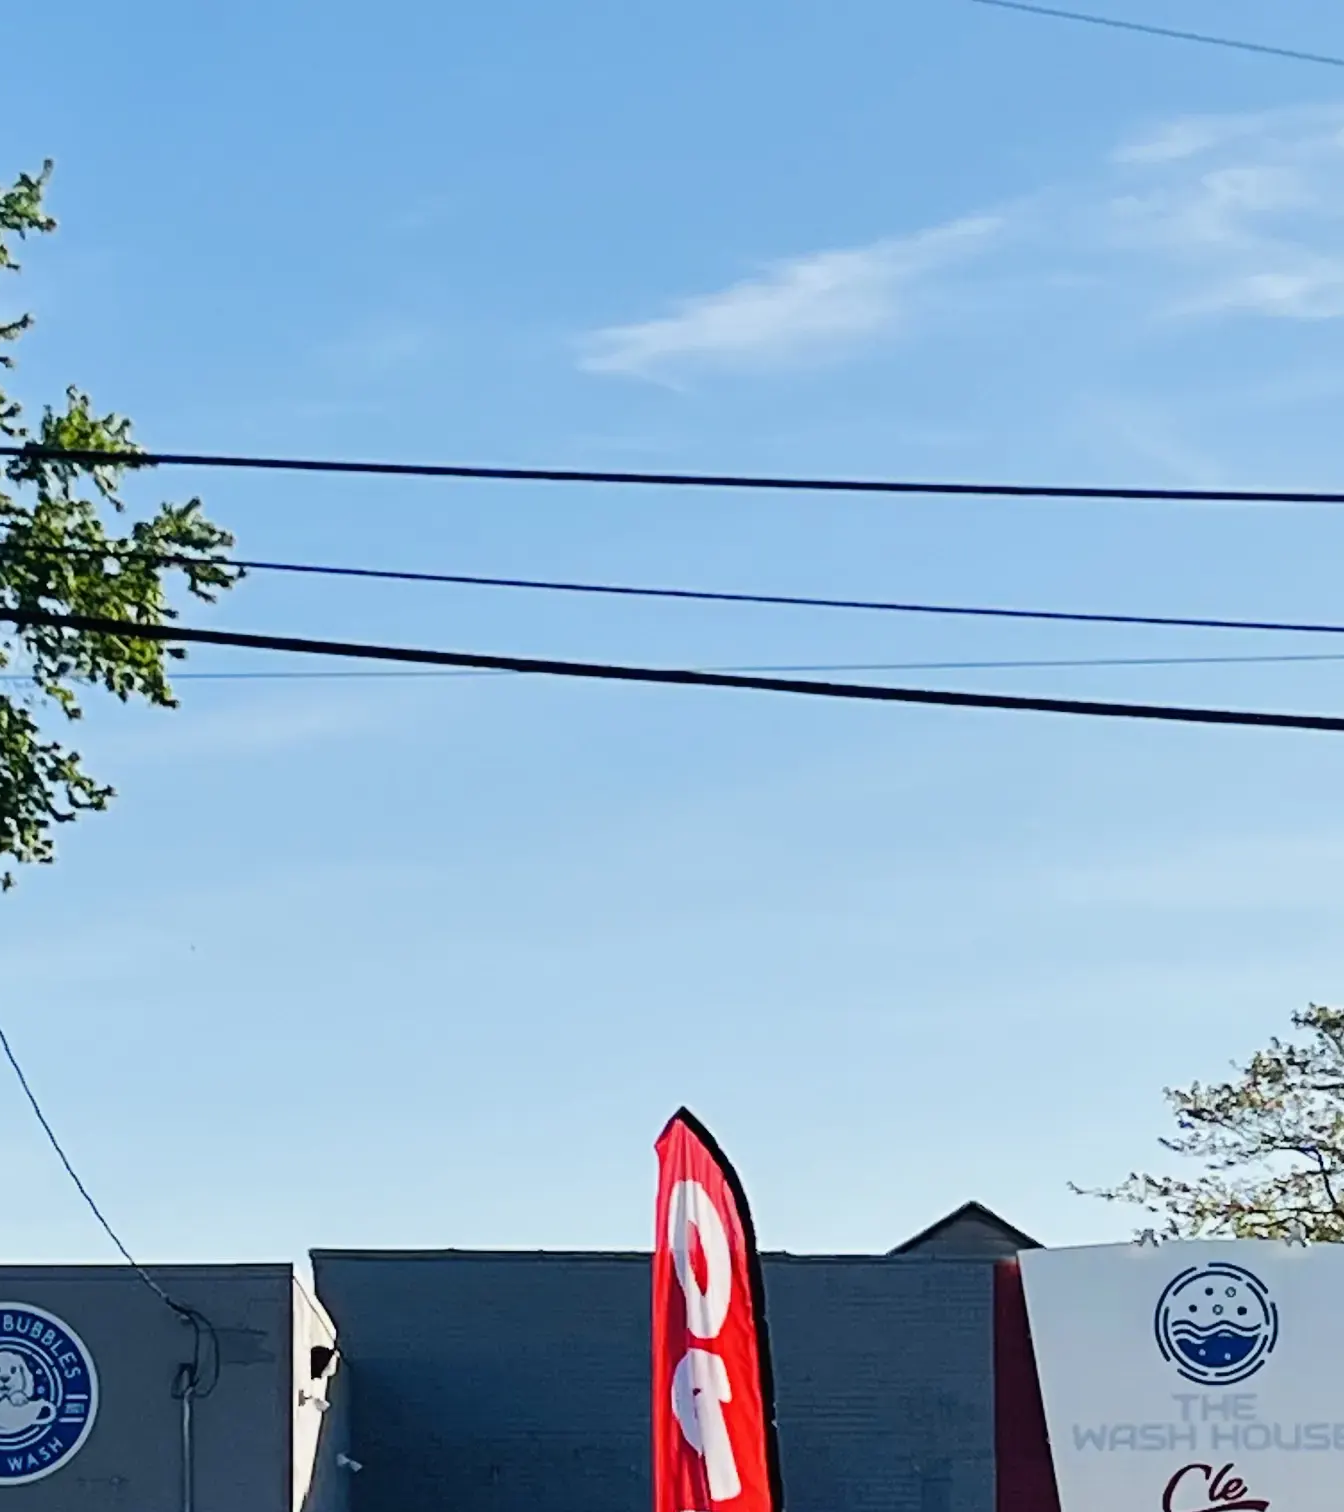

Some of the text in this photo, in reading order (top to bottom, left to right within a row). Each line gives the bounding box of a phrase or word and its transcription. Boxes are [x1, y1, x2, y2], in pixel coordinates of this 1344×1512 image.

[3, 1314, 81, 1379] BUBBLES
[1171, 1393, 1258, 1422] THE
[1072, 1423, 1196, 1452] WASH
[7, 1437, 64, 1472] WASH
